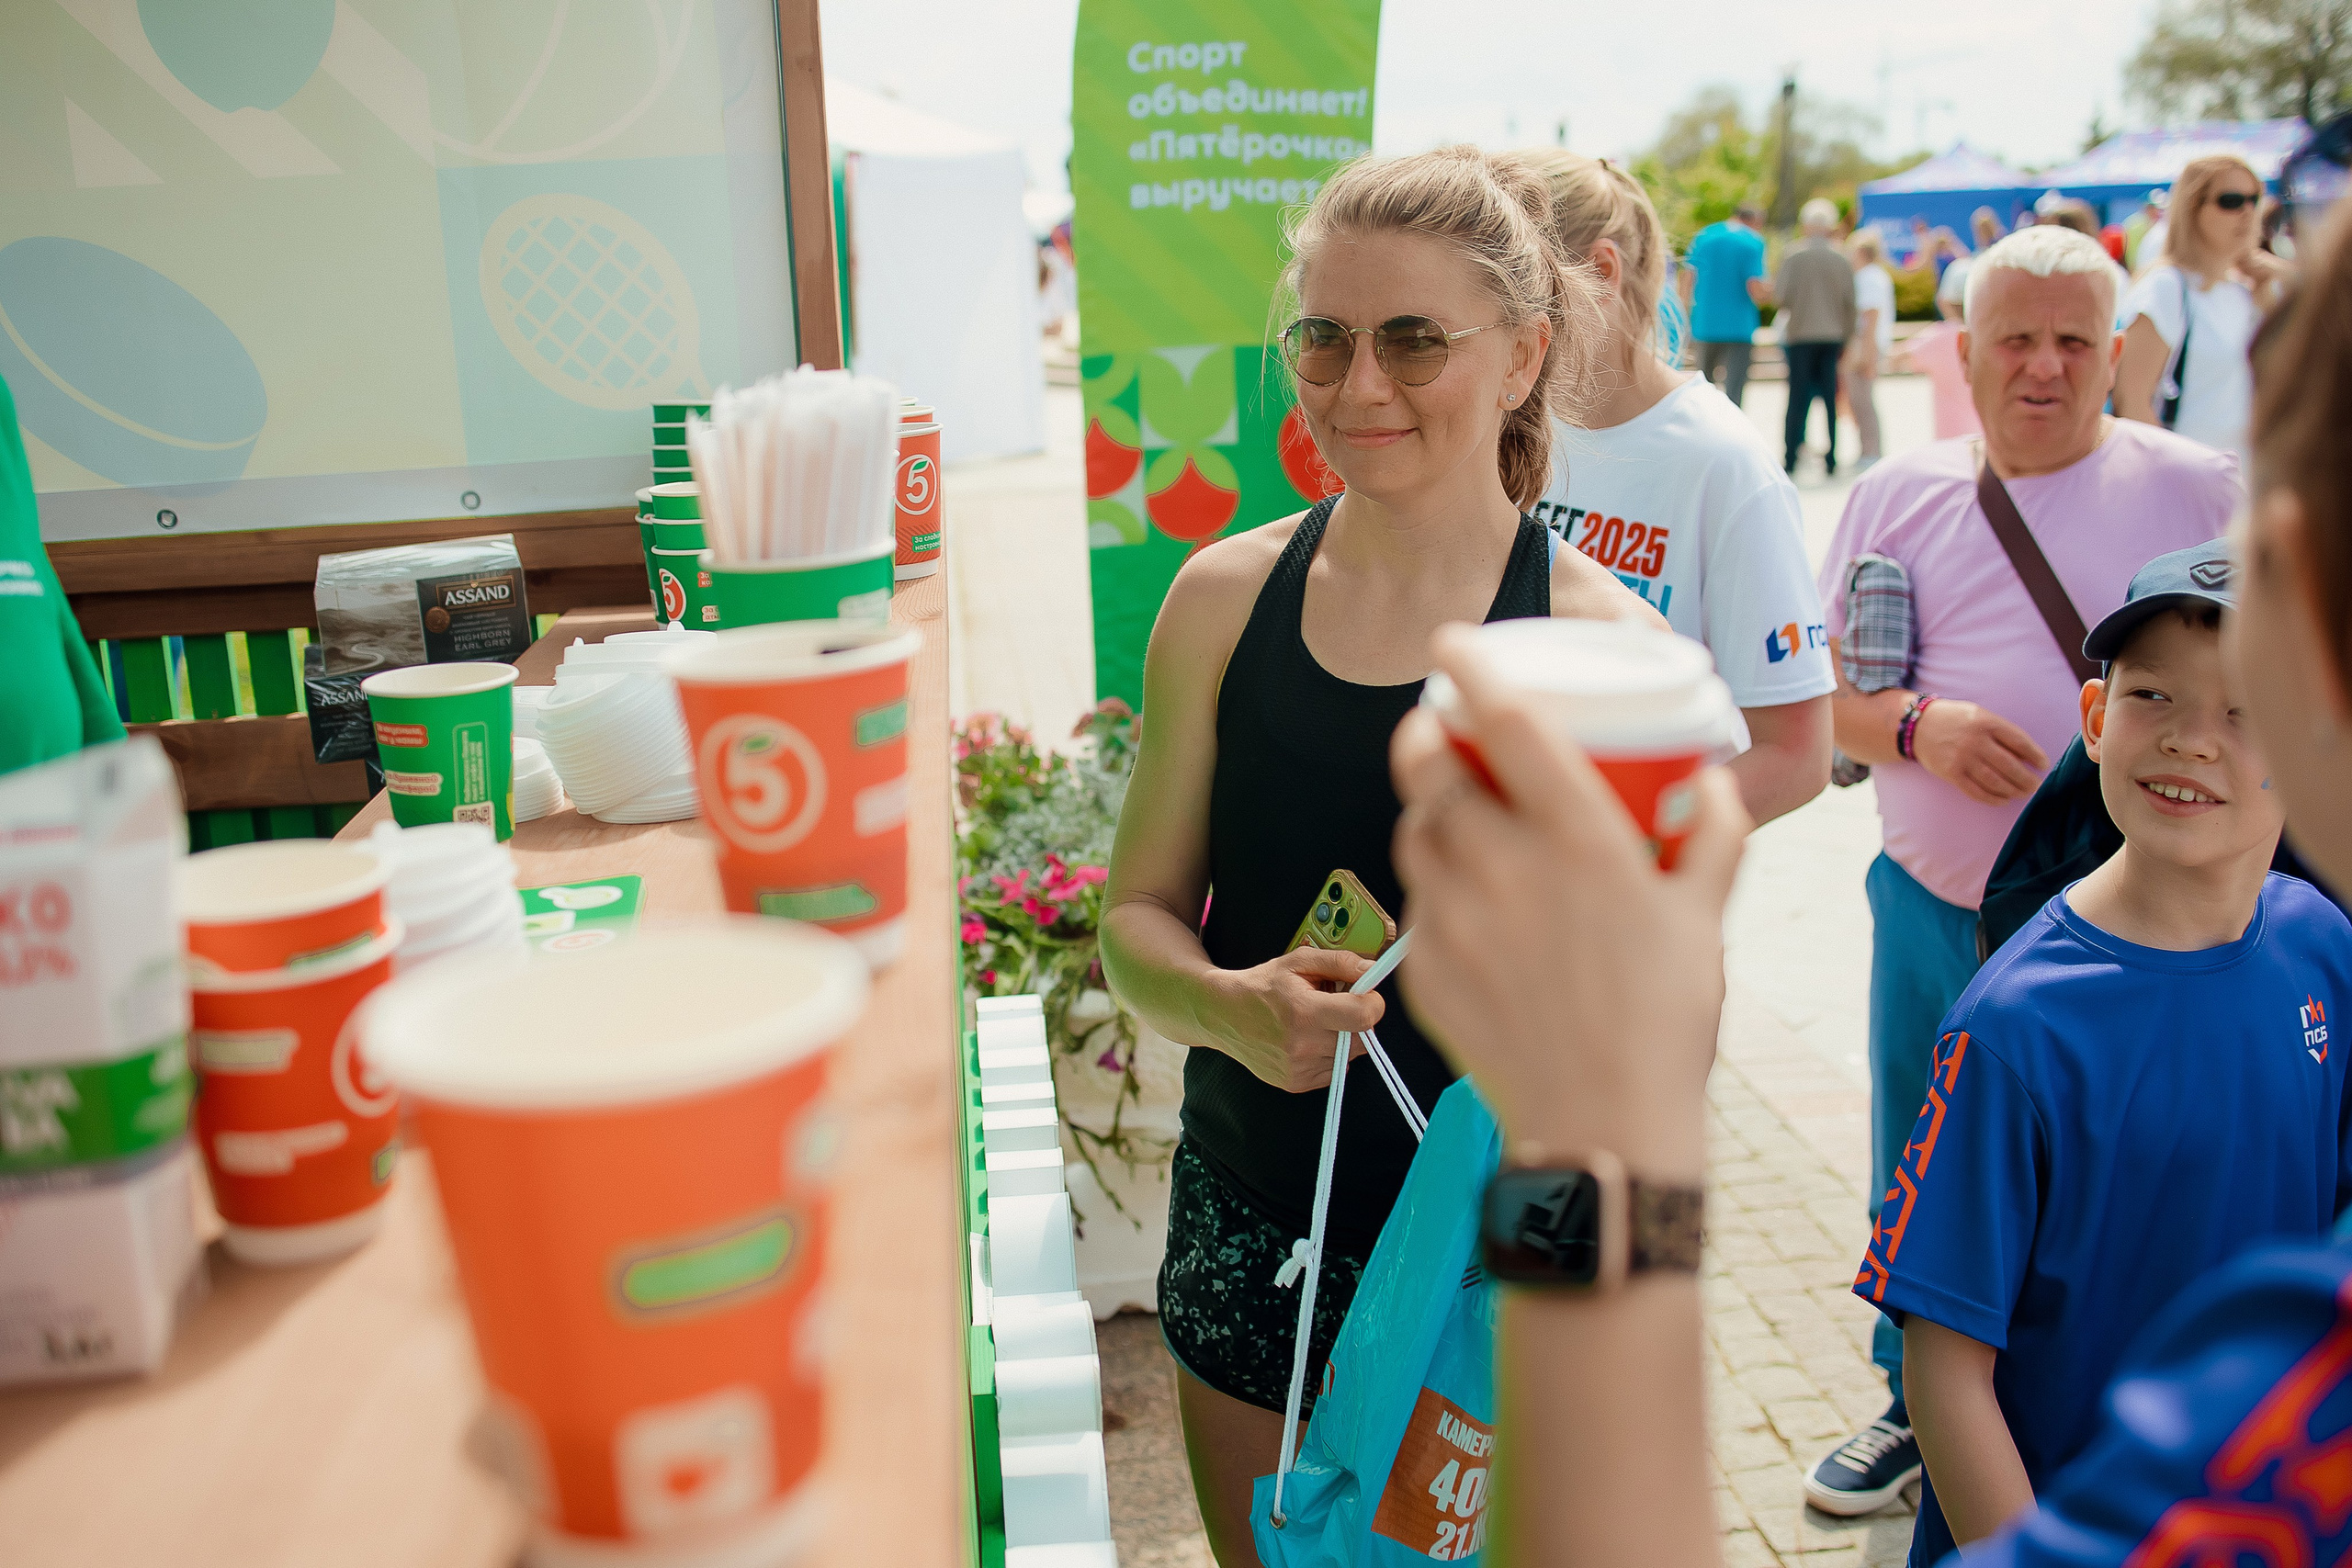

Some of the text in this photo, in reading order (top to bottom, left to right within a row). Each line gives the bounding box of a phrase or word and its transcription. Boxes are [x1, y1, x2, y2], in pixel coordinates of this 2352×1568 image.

[1127, 41, 1246, 74] Спорт
[1128, 79, 1368, 118] объединяет!
[445, 584, 511, 606] ASSAND
[454, 629, 512, 643] HIGHBORN
[455, 637, 512, 652] EARL GREY
[321, 690, 368, 706] ASSAN
[2304, 1026, 2327, 1047] ПСБ
